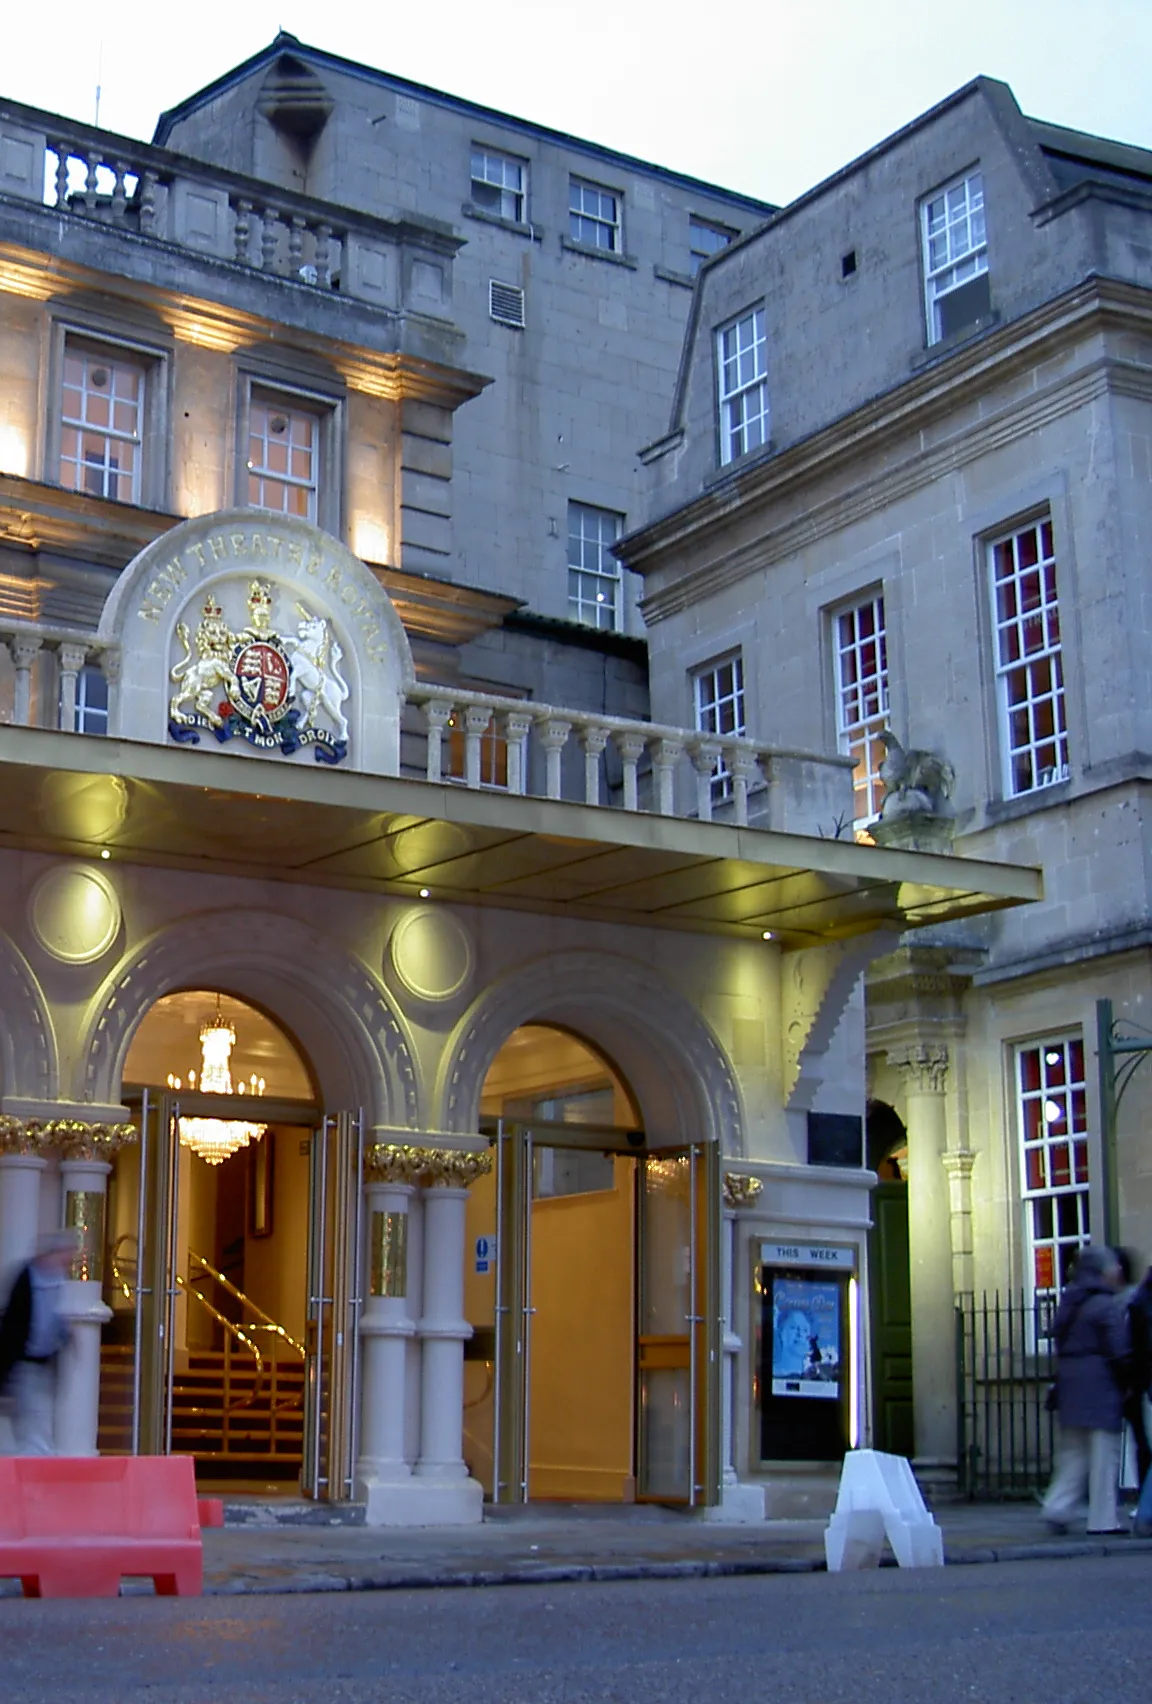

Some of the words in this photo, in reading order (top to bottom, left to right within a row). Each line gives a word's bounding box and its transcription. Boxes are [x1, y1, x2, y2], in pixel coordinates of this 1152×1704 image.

[137, 556, 188, 624] NEW
[186, 533, 325, 576] THEATRE
[323, 566, 388, 662] ROYAL
[254, 731, 284, 748] MON
[299, 729, 337, 746] DROIT
[777, 1247, 800, 1258] THIS
[810, 1249, 838, 1260] WEEK
